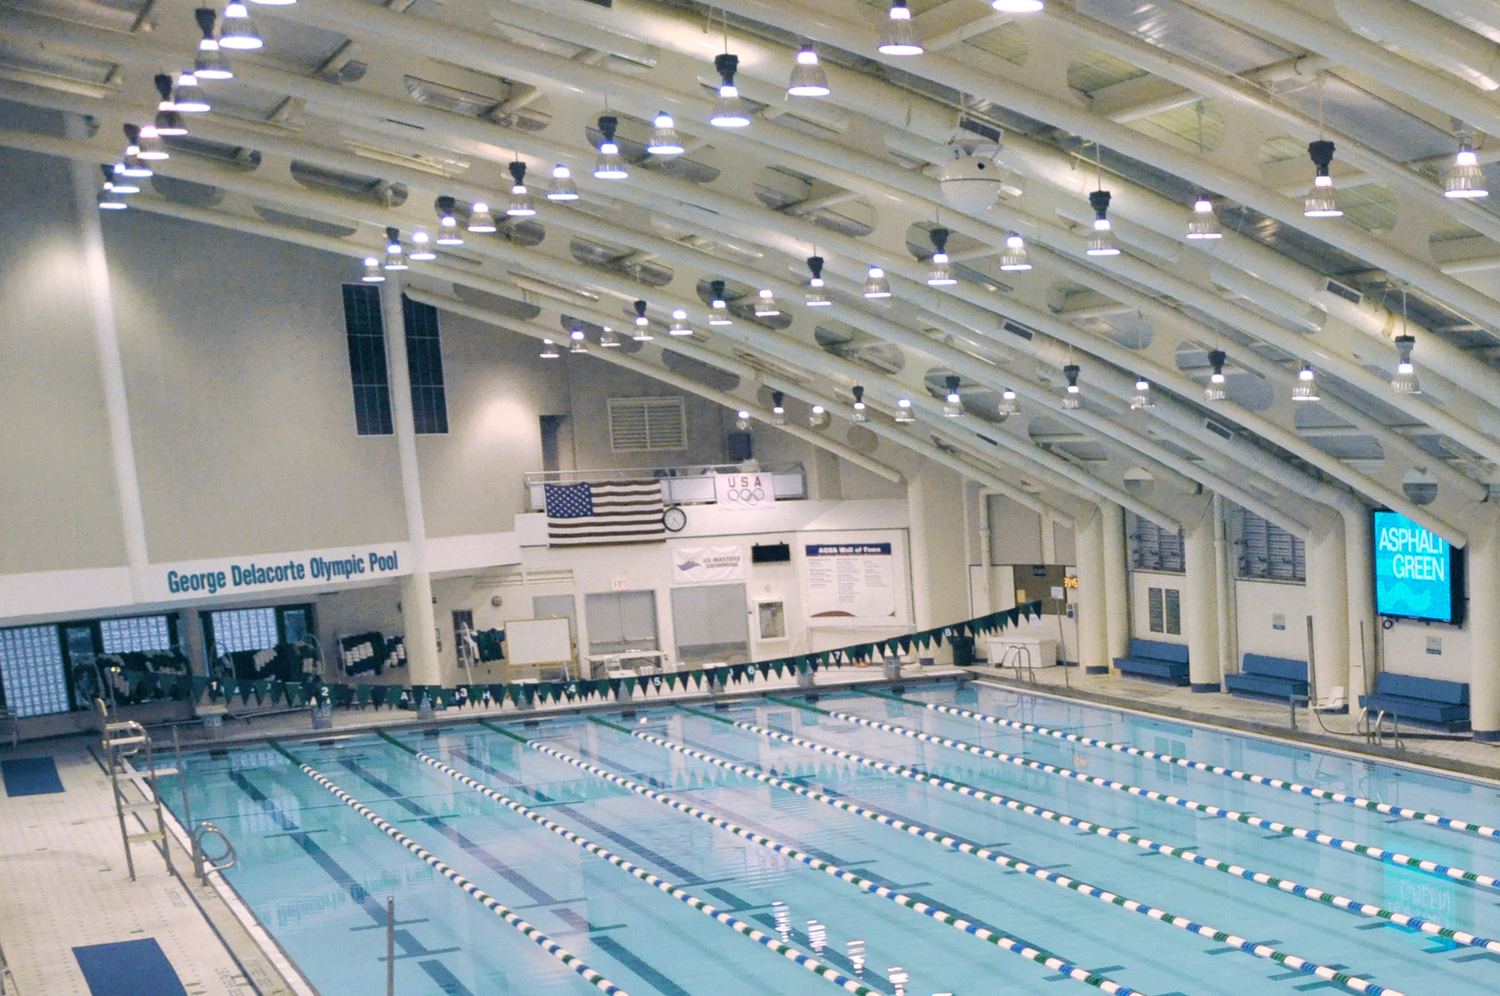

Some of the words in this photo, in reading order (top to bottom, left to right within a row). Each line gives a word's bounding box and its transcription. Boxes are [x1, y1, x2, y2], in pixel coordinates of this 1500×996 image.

[728, 476, 762, 488] USA
[168, 570, 226, 595] George
[231, 560, 305, 587] Delacorte
[309, 553, 365, 582] Olympic
[369, 550, 398, 572] Pool
[1393, 554, 1444, 581] GREEN
[321, 686, 330, 697] 2
